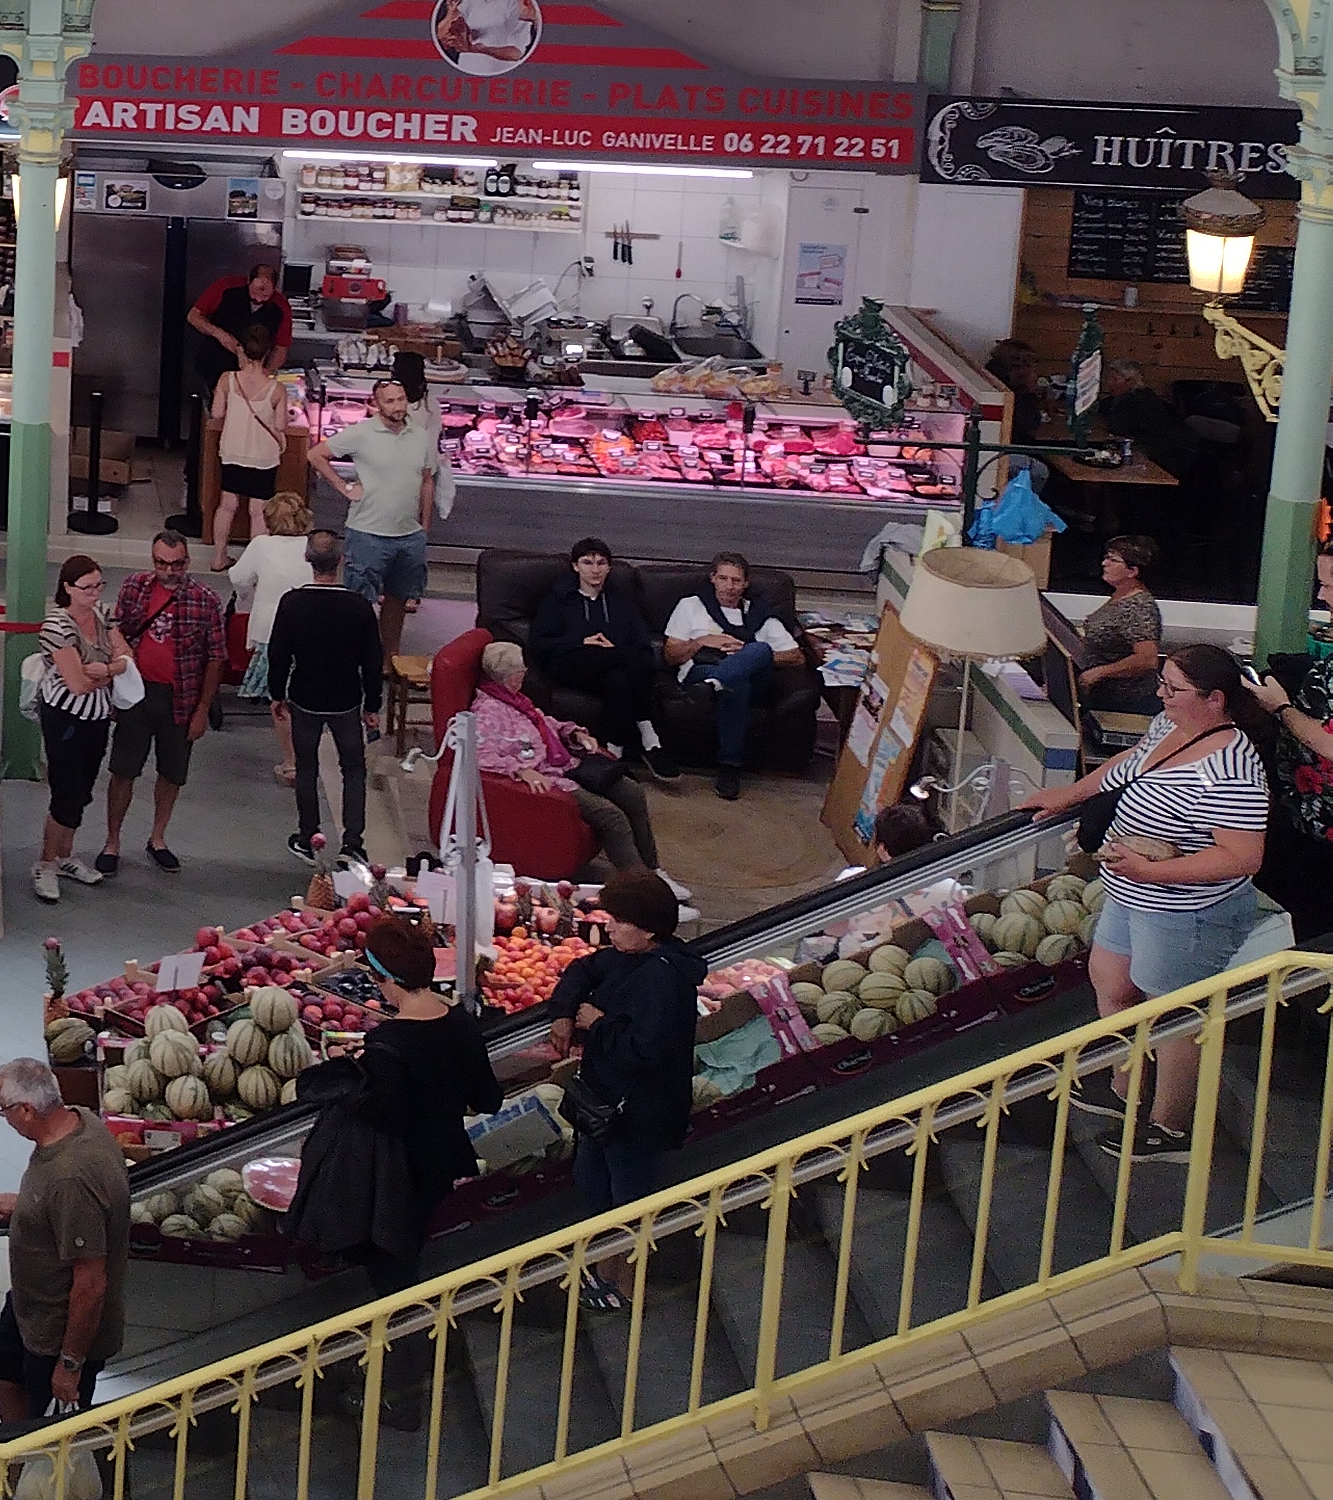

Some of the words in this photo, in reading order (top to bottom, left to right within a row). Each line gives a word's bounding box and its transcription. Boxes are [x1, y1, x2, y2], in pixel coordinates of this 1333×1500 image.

[79, 63, 280, 95] BOUCHERIE
[315, 72, 572, 107] CHARCUTERIE
[608, 83, 728, 114] PLATS
[738, 87, 915, 120] CUISINES
[81, 101, 259, 133] ARTISAN
[282, 108, 478, 142] BOUCHER
[490, 127, 592, 147] JEAN-LUC
[602, 131, 714, 152] GANIVELLE
[723, 132, 754, 153] 06
[760, 134, 790, 155] 22
[796, 135, 826, 156] 71
[834, 136, 865, 158] 22
[871, 138, 901, 159] 51
[1091, 127, 1288, 178] HUÎTRES
